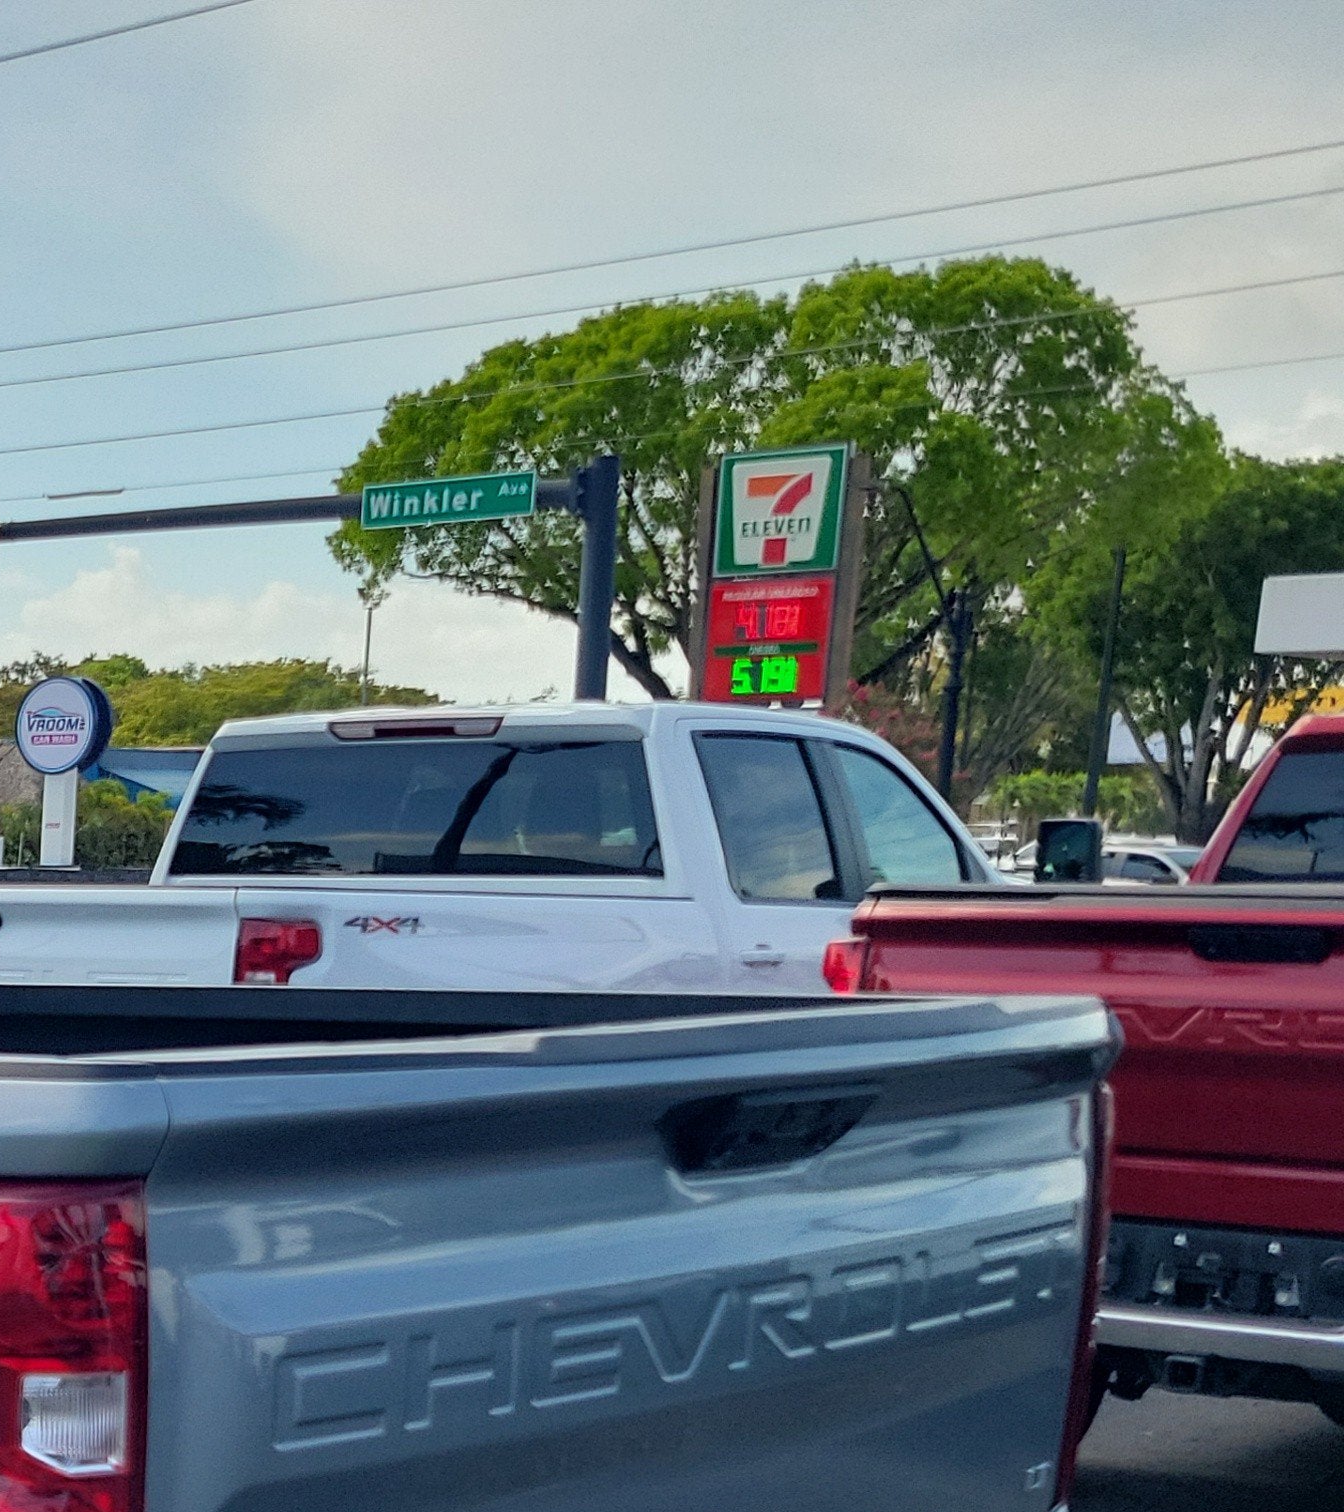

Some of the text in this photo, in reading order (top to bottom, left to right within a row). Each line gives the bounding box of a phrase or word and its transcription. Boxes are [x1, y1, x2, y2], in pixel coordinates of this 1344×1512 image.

[369, 479, 529, 520] Winkler Ave
[746, 471, 813, 565] 7
[27, 711, 79, 732] VROOM
[274, 1217, 1076, 1451] CHEVROLET
